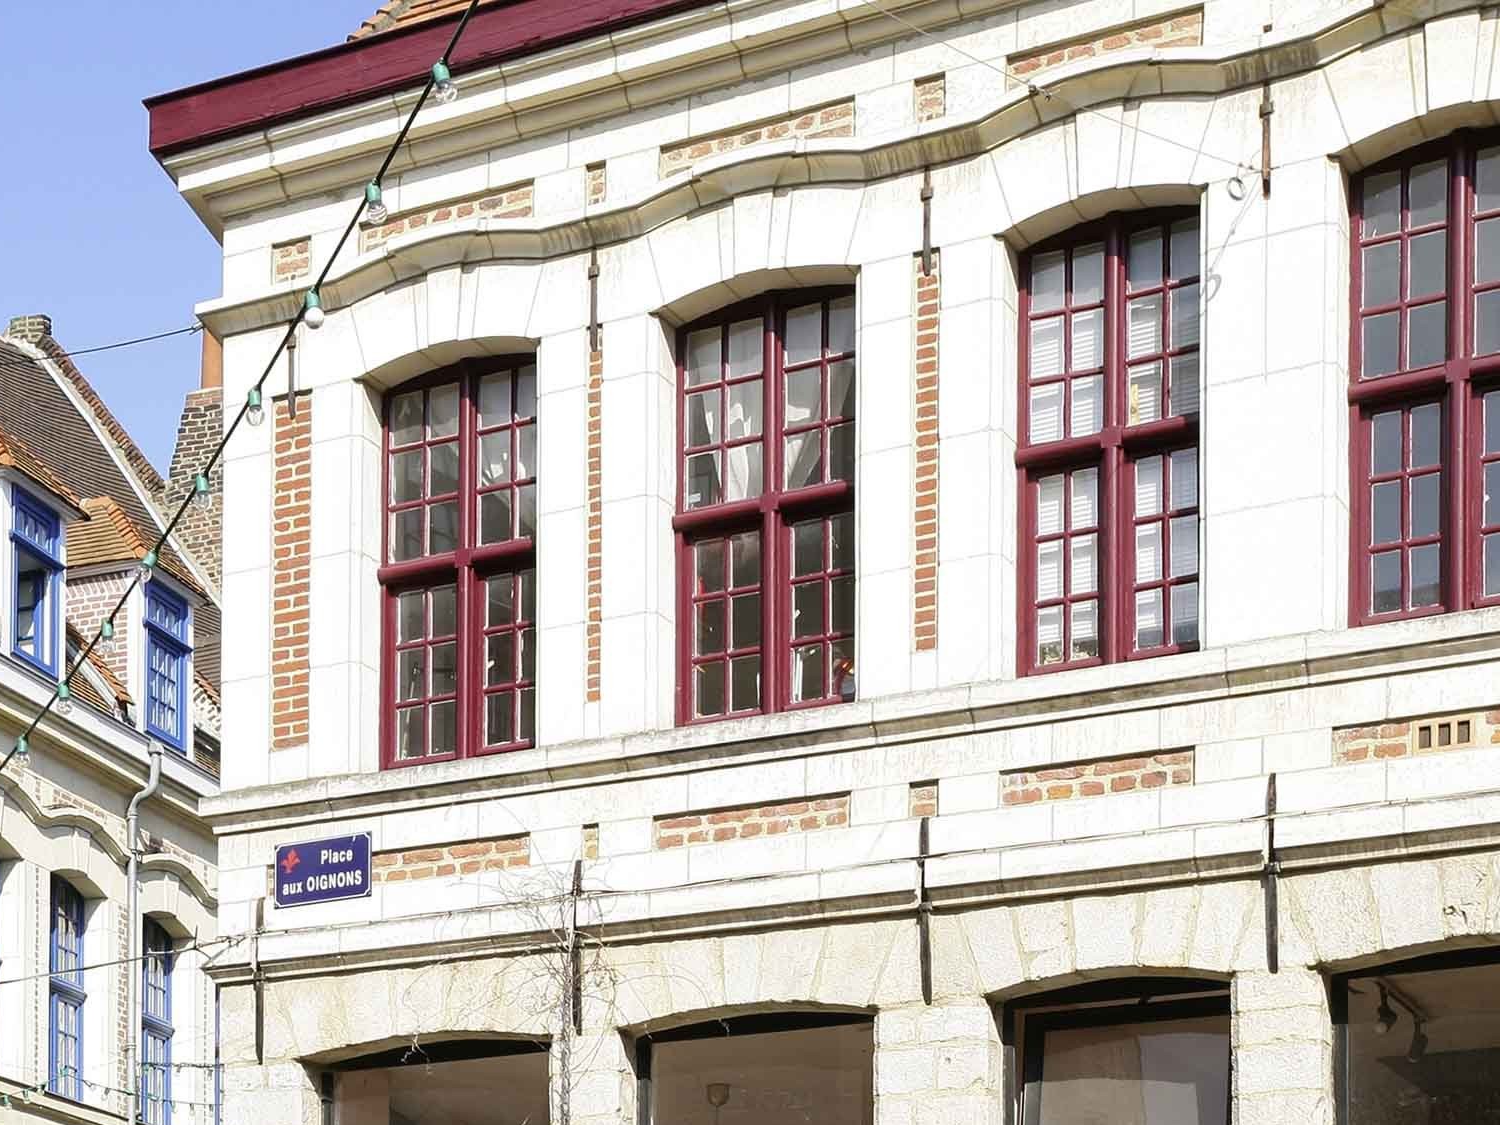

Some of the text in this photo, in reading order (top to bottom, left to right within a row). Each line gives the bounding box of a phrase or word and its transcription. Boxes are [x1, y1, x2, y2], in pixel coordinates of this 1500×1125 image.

[321, 849, 353, 865] Place
[283, 869, 362, 896] aux OIGNONS
